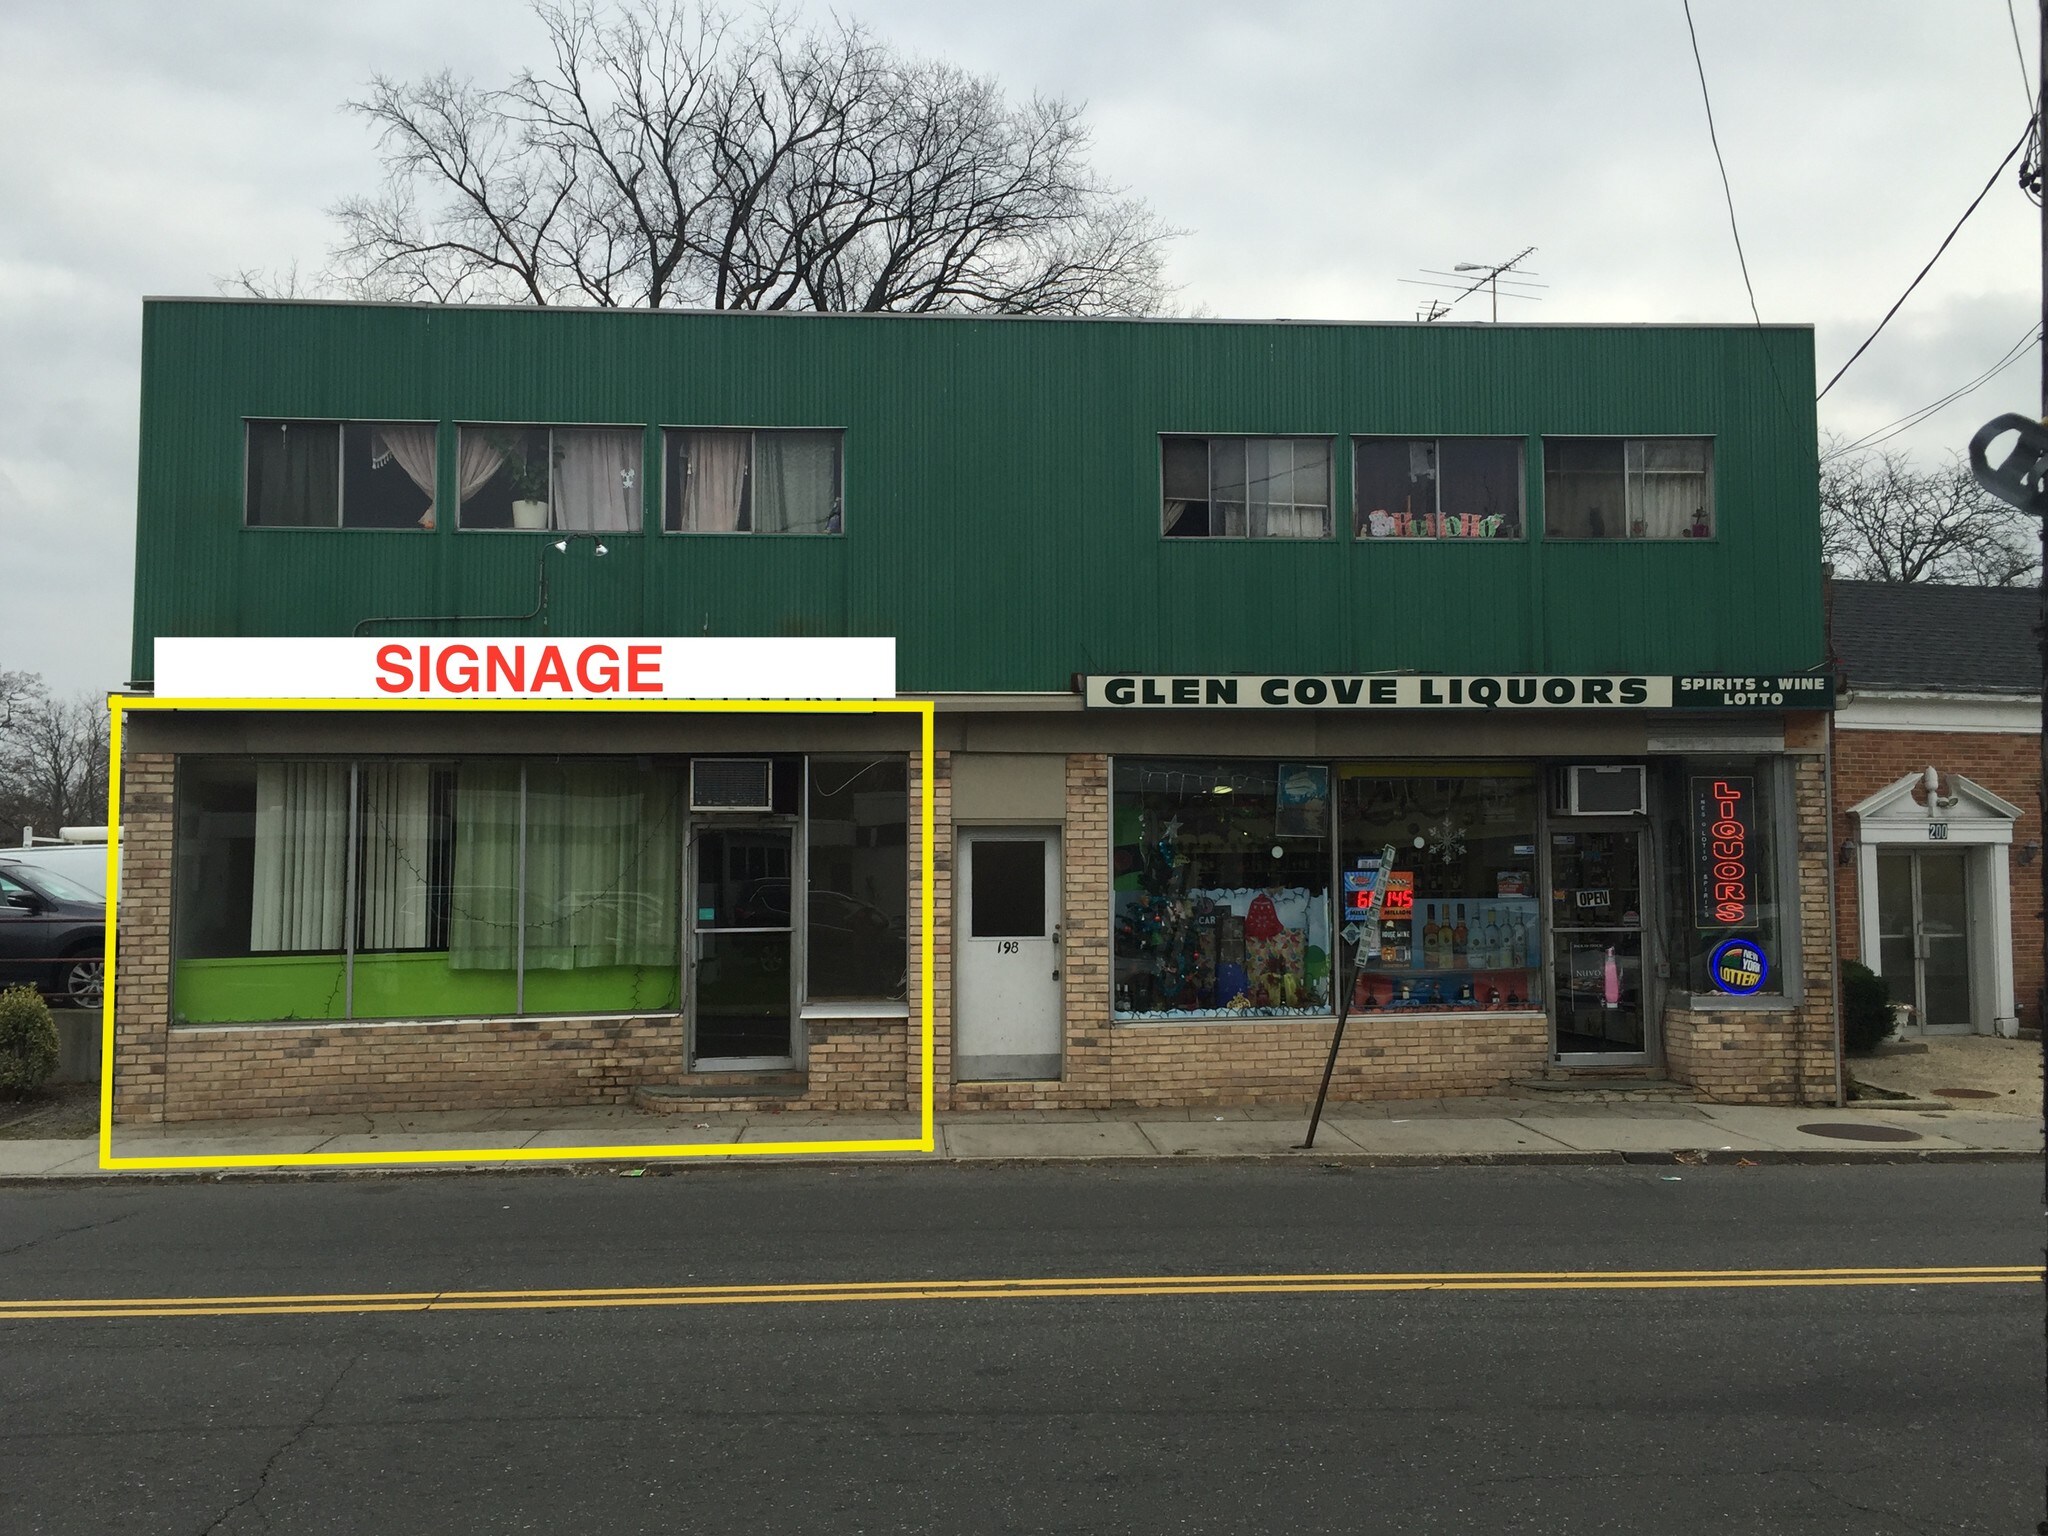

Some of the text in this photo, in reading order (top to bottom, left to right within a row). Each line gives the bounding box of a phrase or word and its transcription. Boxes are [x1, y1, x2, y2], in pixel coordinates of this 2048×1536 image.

[1681, 678, 1826, 690] SPIRITS WINE
[1105, 678, 1650, 709] GLEN COVE LIQUORS
[1724, 692, 1784, 706] LOTTO
[1929, 824, 1947, 838] 200
[1711, 781, 1746, 923] LIQUORS
[1386, 889, 1414, 909] 145
[1579, 891, 1609, 906] OPEN
[997, 941, 1019, 954] 198
[1743, 949, 1759, 962] NEW
[1576, 969, 1602, 977] NUVO
